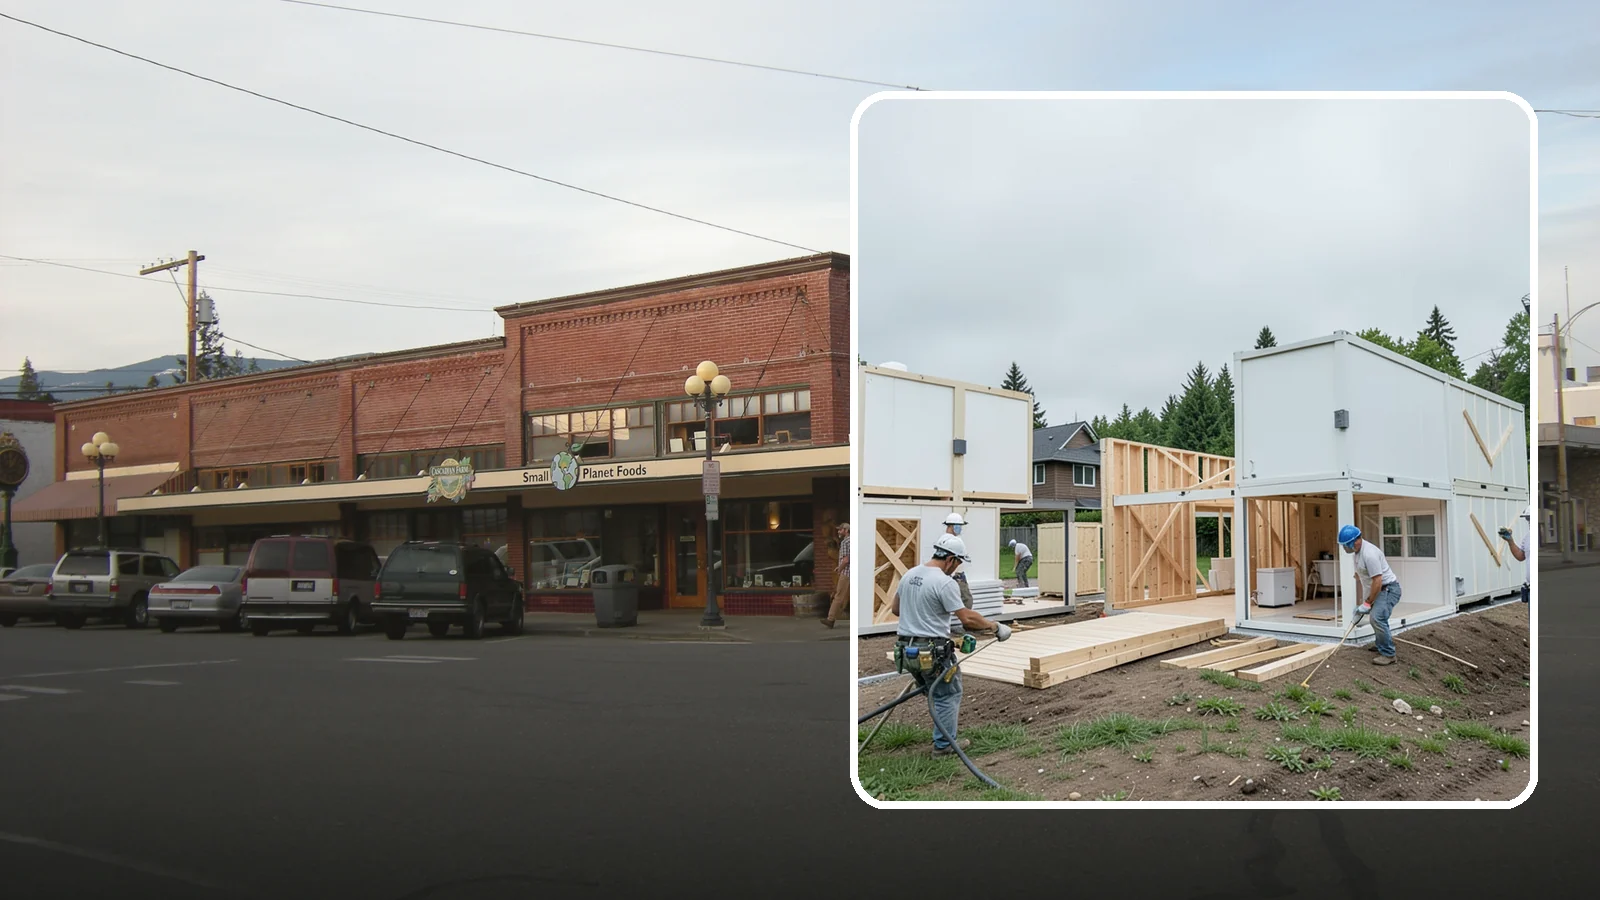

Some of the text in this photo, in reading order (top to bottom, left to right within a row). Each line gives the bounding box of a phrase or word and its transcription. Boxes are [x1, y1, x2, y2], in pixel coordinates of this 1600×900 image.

[523, 464, 647, 483] Small Planet Foods
